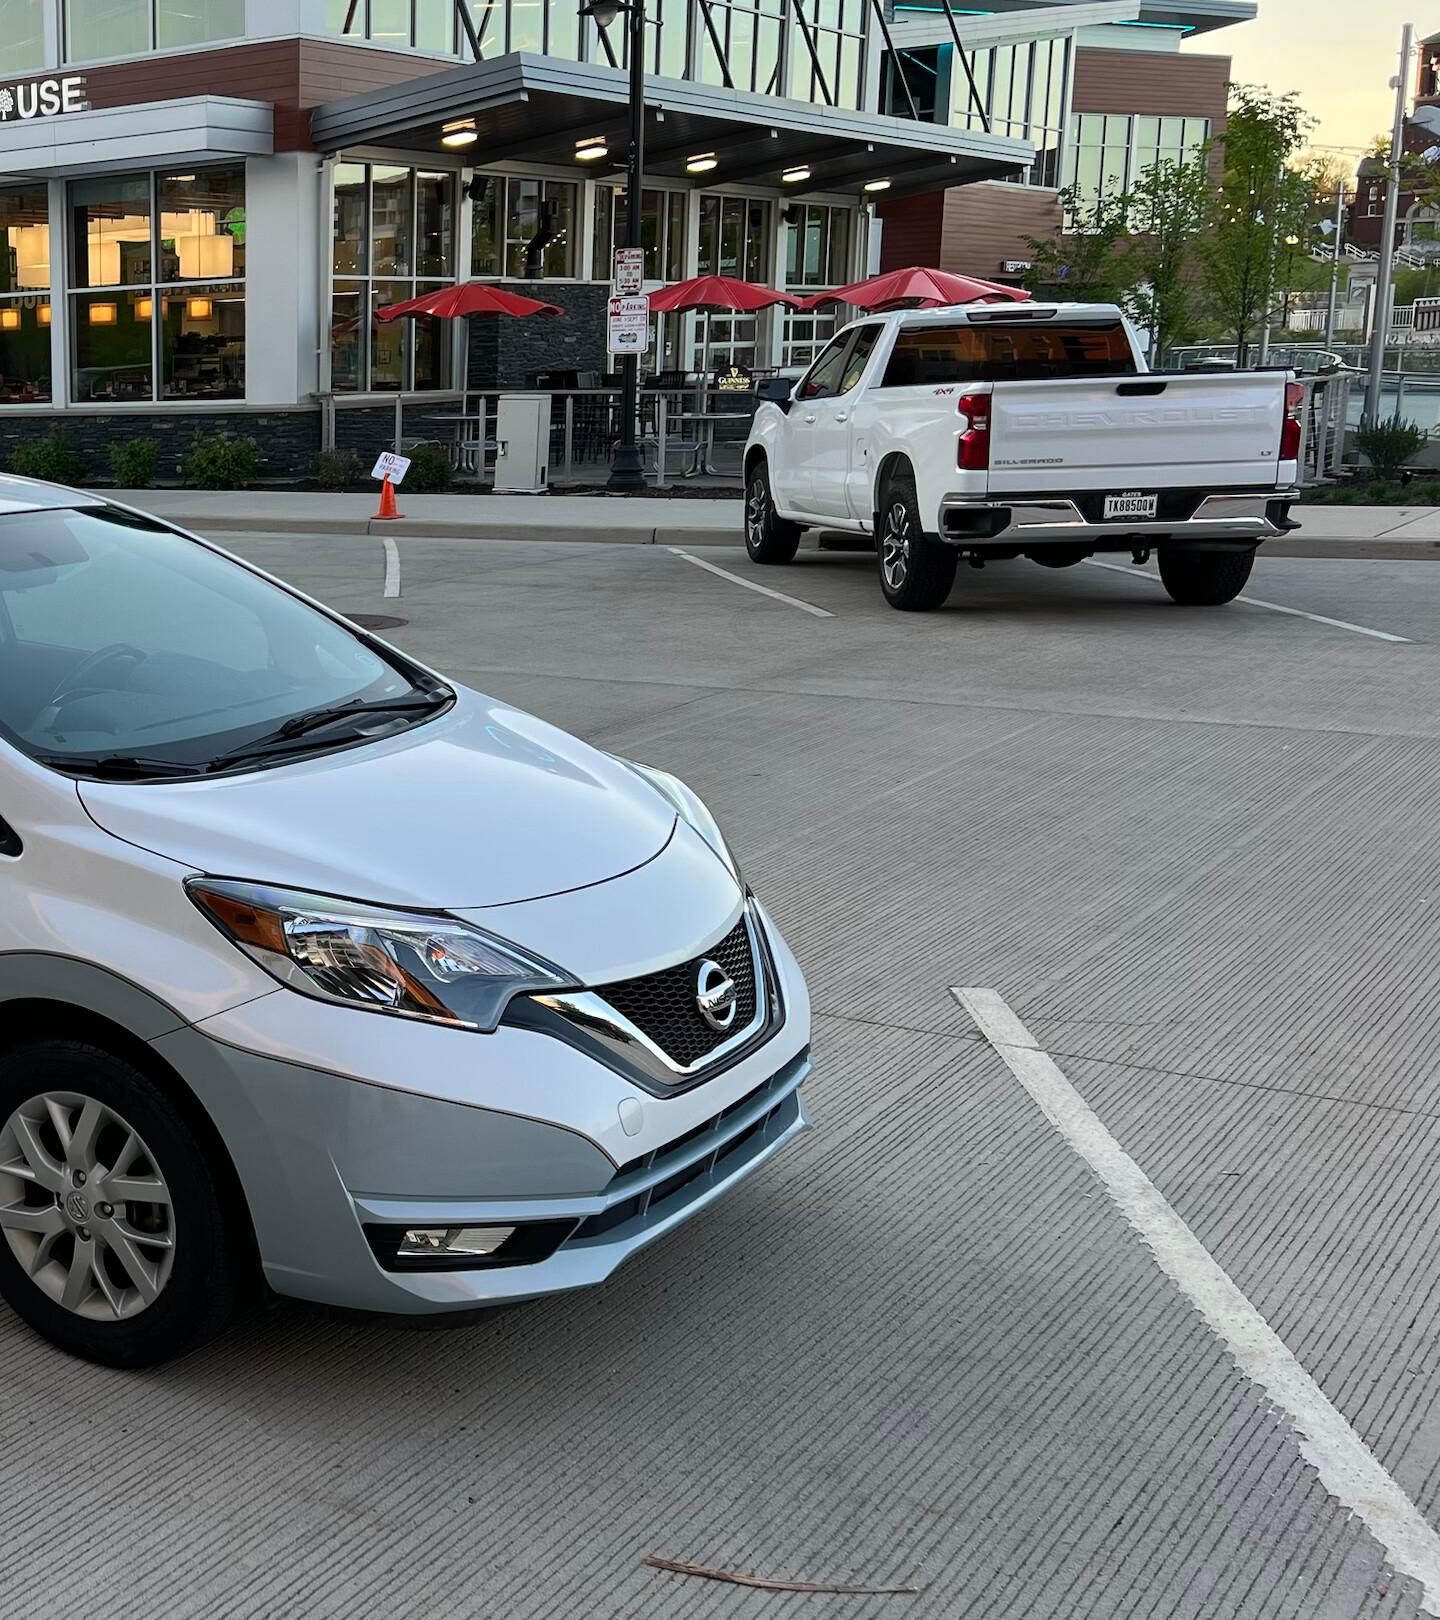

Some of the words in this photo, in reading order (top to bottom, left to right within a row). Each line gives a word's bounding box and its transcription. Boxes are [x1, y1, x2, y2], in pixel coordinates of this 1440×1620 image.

[610, 301, 621, 313] NO
[622, 303, 647, 311] PARKING
[718, 376, 751, 385] GUINNESS
[1013, 406, 1266, 430] CHEVROLET
[383, 454, 396, 466] NO
[994, 457, 1064, 465] SILVERADO
